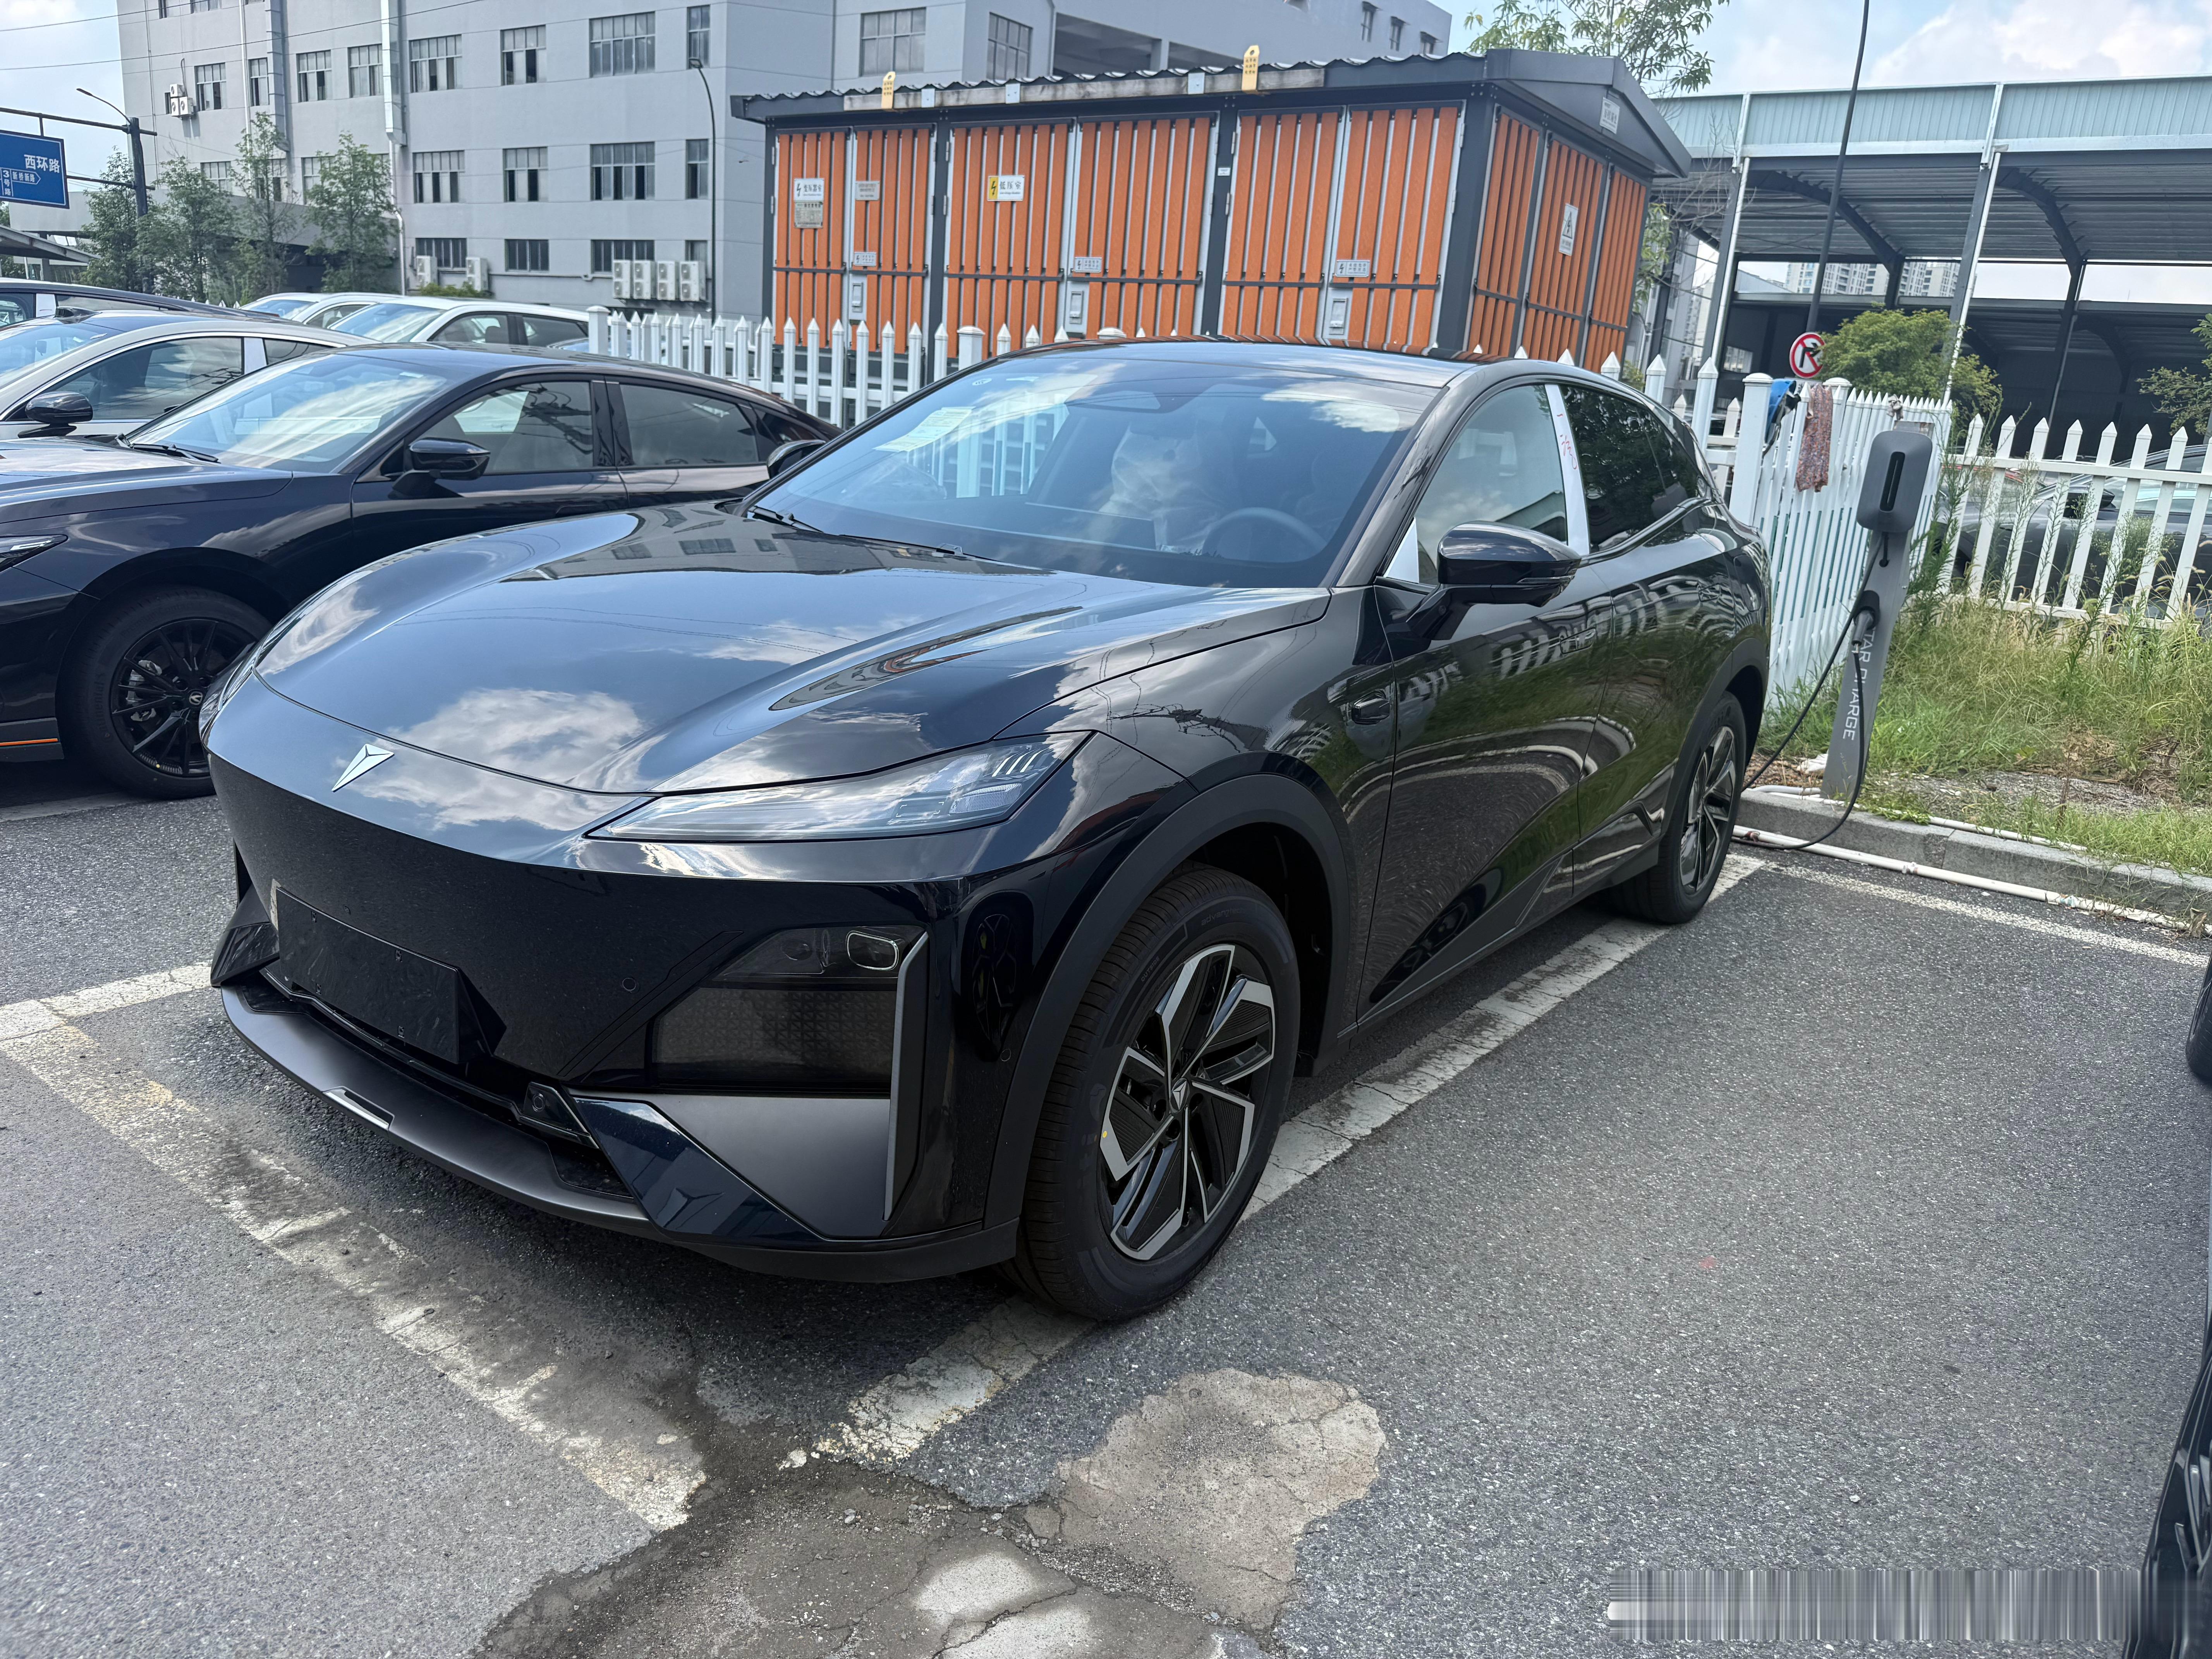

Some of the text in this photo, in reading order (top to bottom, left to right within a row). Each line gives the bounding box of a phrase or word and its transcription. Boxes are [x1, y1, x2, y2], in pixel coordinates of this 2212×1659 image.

[24, 154, 60, 173] 西环路
[3, 170, 11, 196] 3号路
[1859, 626, 1876, 663] TAR
[1140, 956, 1160, 982] OUTSIDE
